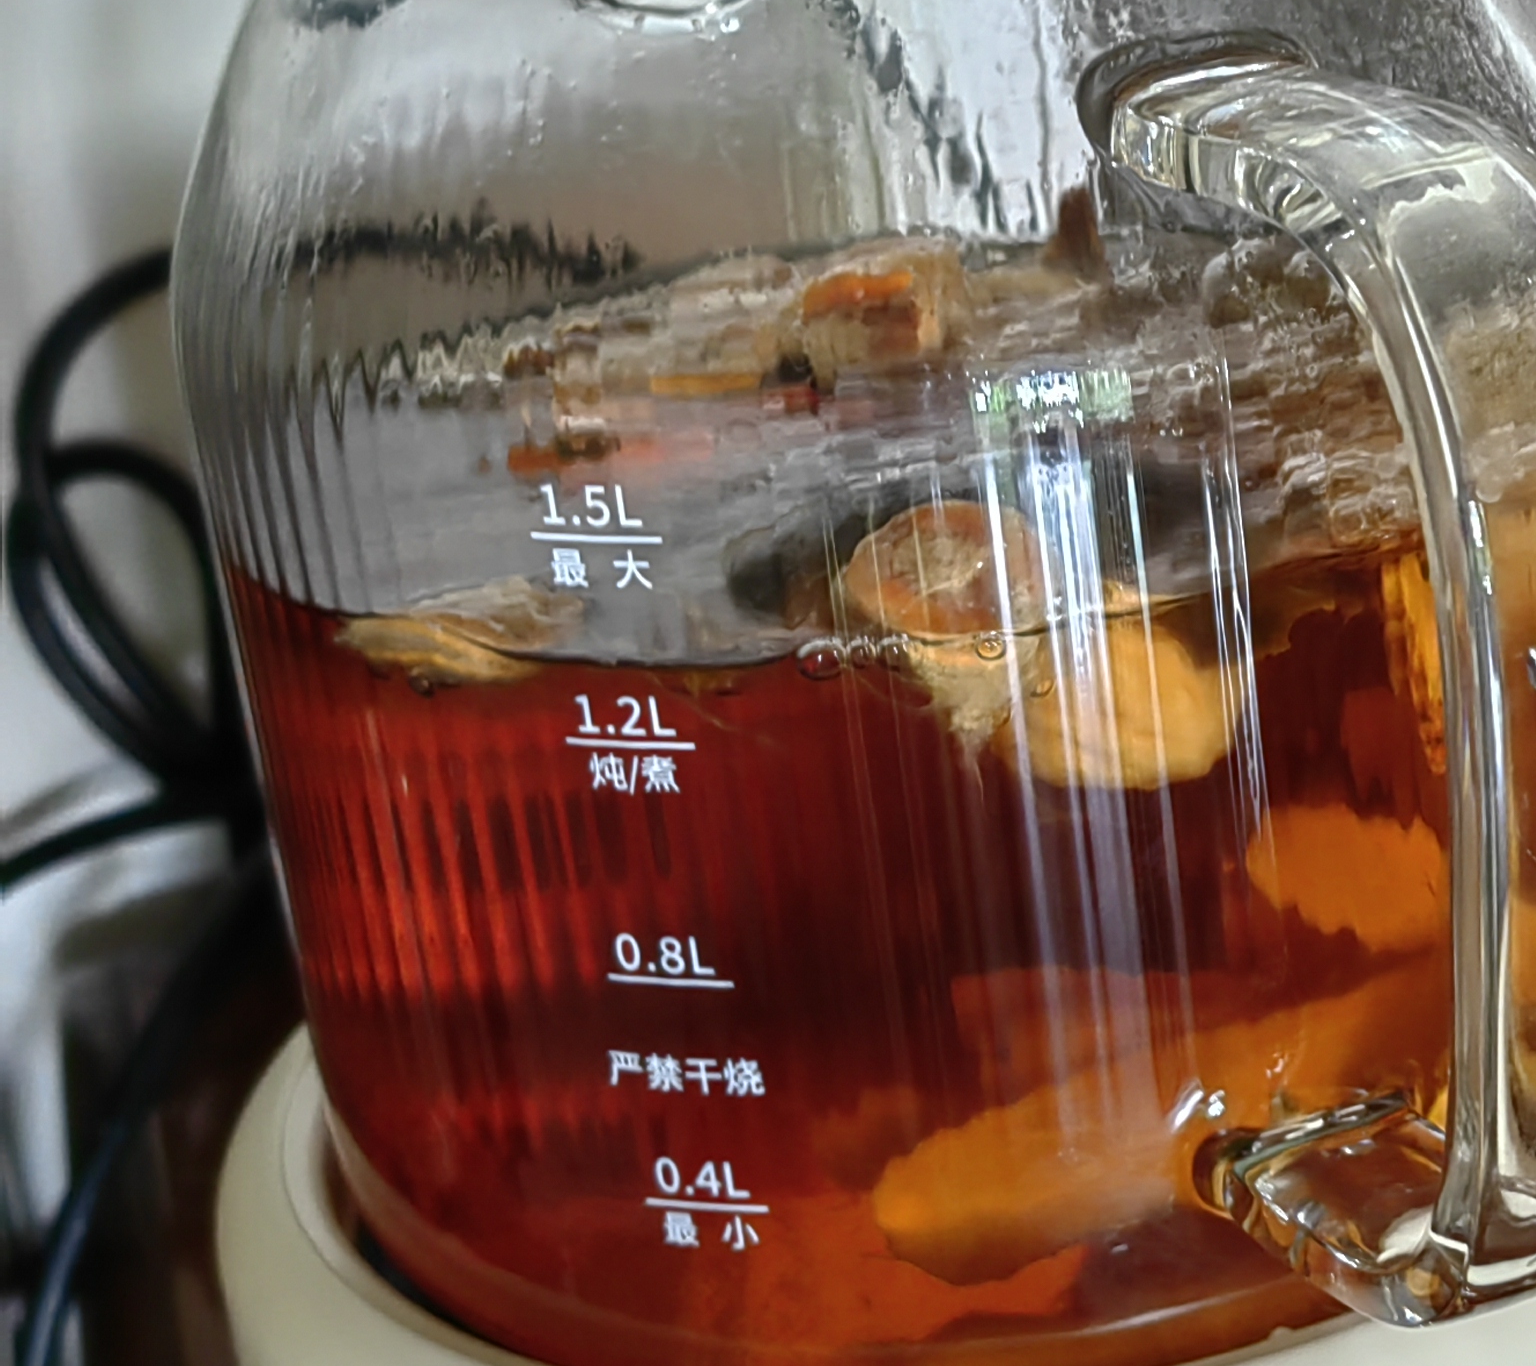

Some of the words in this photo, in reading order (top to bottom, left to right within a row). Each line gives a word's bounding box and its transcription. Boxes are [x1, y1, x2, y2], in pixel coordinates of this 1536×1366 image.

[539, 483, 644, 528] 1.5L
[551, 547, 654, 590] 最大
[574, 693, 678, 737] 1.2L
[588, 751, 681, 796] 炖/煮
[614, 932, 716, 977] 0.8L
[607, 1049, 766, 1097] 严禁干烧
[654, 1156, 751, 1199] 0.4L
[663, 1211, 760, 1251] 最小
